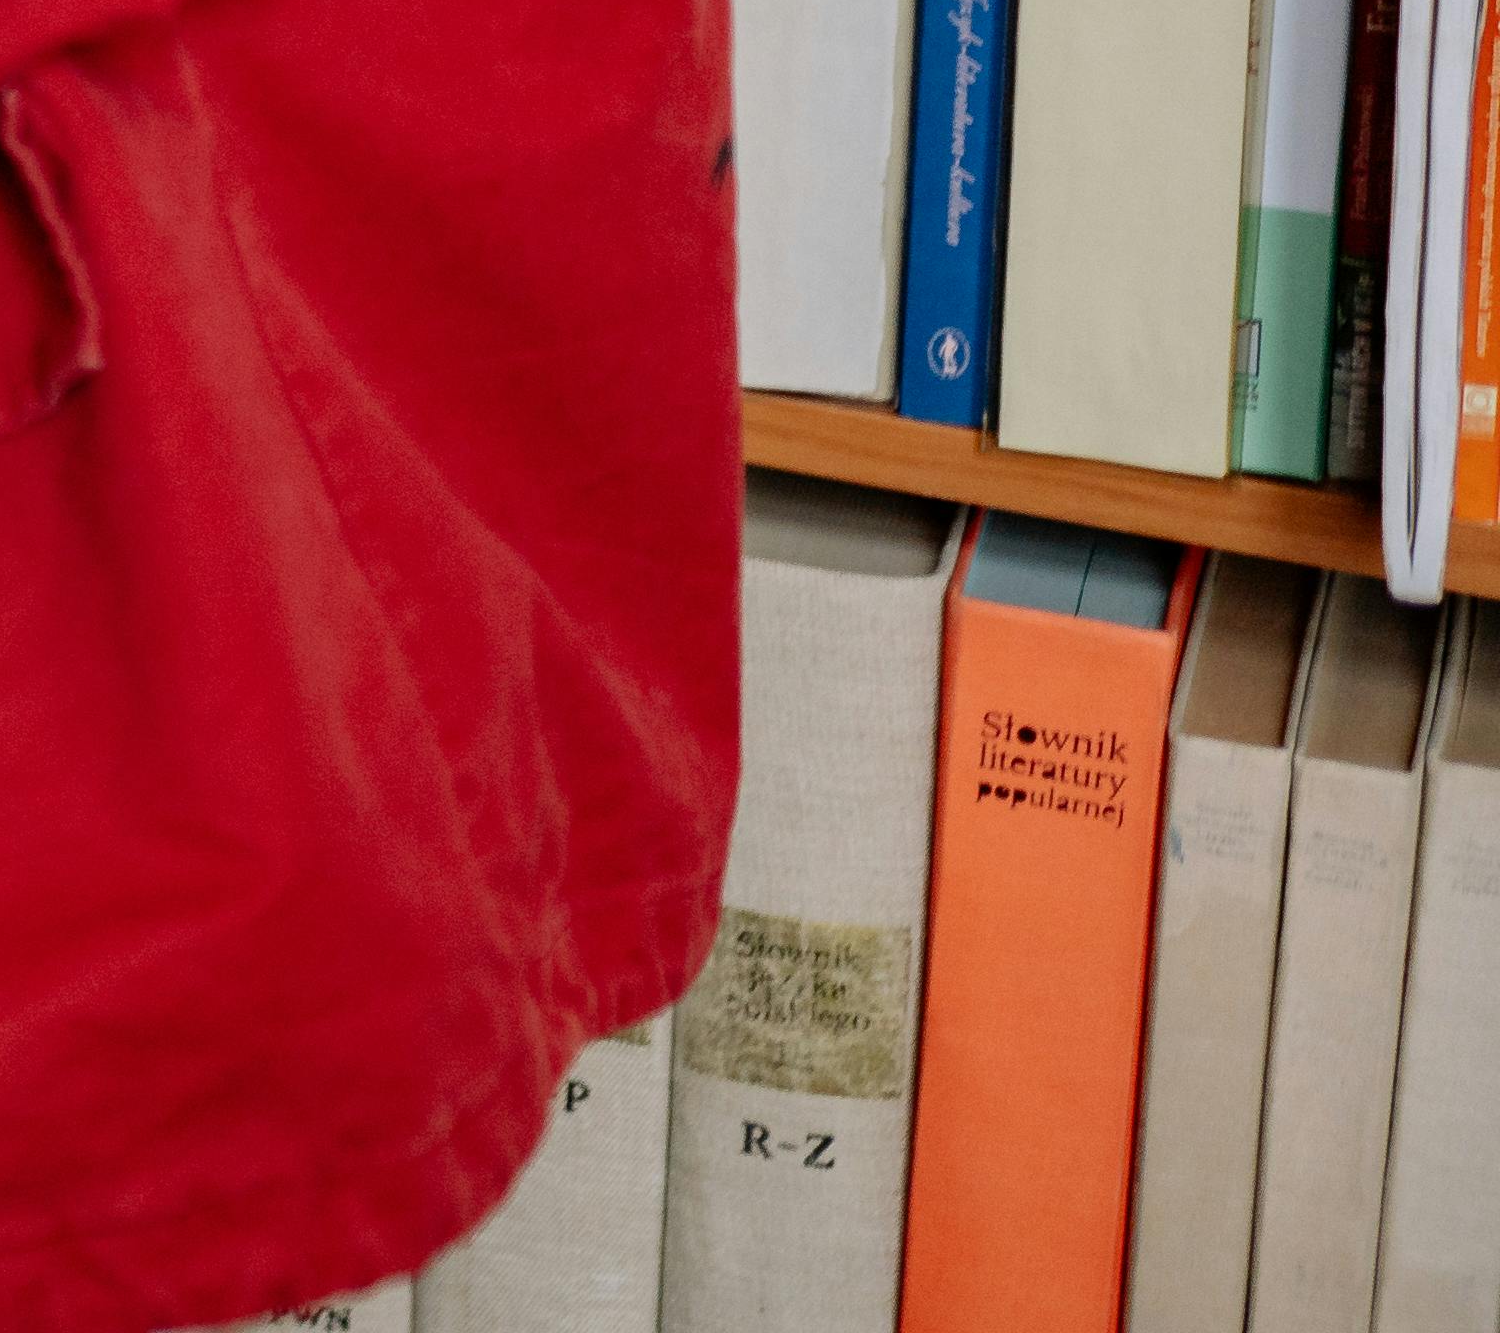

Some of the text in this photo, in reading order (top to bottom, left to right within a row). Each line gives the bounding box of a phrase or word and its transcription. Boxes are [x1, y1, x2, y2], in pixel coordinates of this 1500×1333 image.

[980, 708, 1129, 766] Słownik
[977, 741, 1128, 799] literatury
[973, 780, 1127, 831] popularnej
[740, 1118, 837, 1171] R-Z
